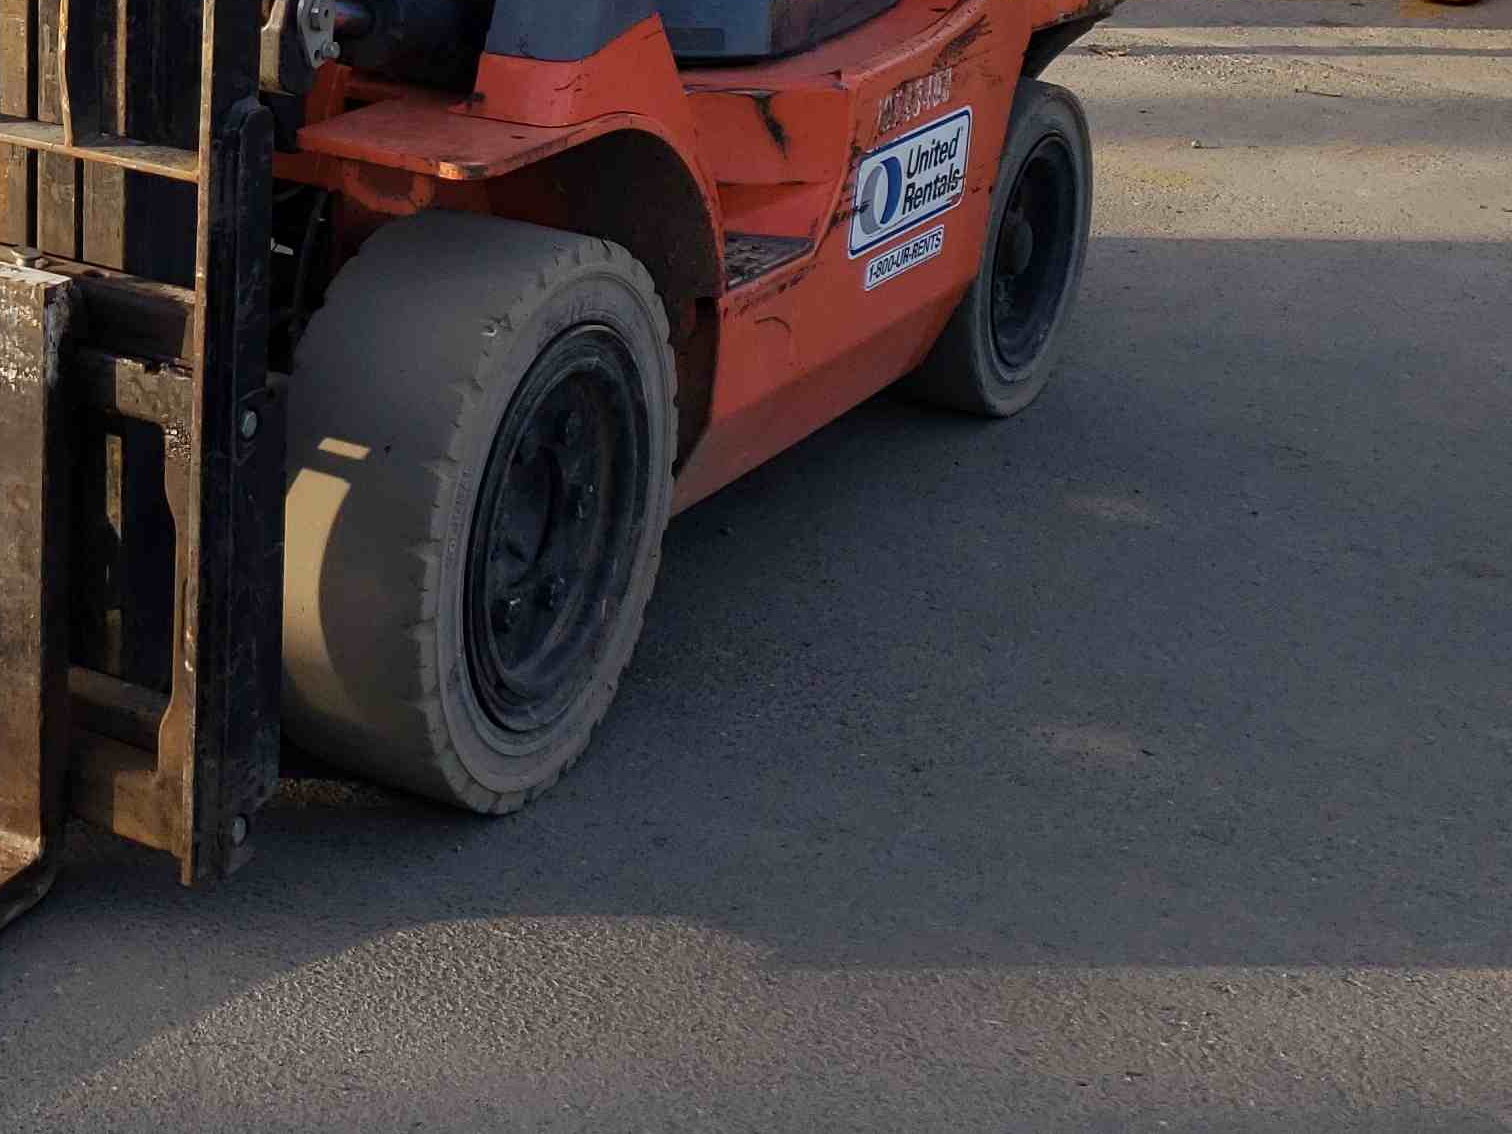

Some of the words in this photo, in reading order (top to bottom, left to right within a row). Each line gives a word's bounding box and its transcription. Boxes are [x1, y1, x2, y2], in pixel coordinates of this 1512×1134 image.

[907, 126, 961, 180] United
[901, 163, 962, 215] Rentals
[868, 230, 942, 283] 1-800-UR-RENTS
